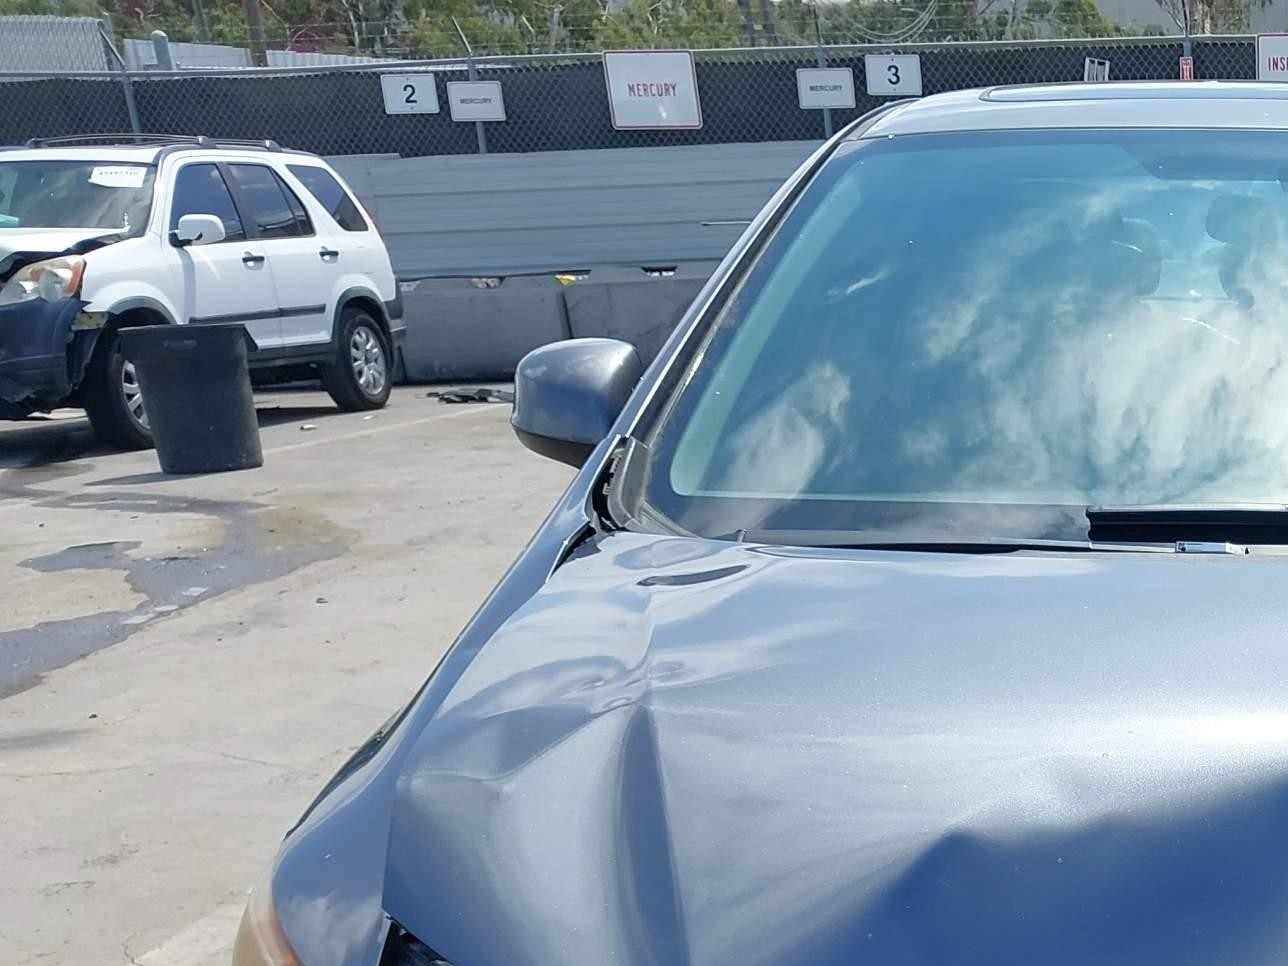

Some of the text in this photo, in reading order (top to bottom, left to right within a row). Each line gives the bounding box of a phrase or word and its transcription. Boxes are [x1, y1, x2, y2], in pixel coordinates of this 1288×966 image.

[887, 65, 900, 85] 3
[403, 84, 418, 103] 2
[627, 83, 677, 97] MERCURY
